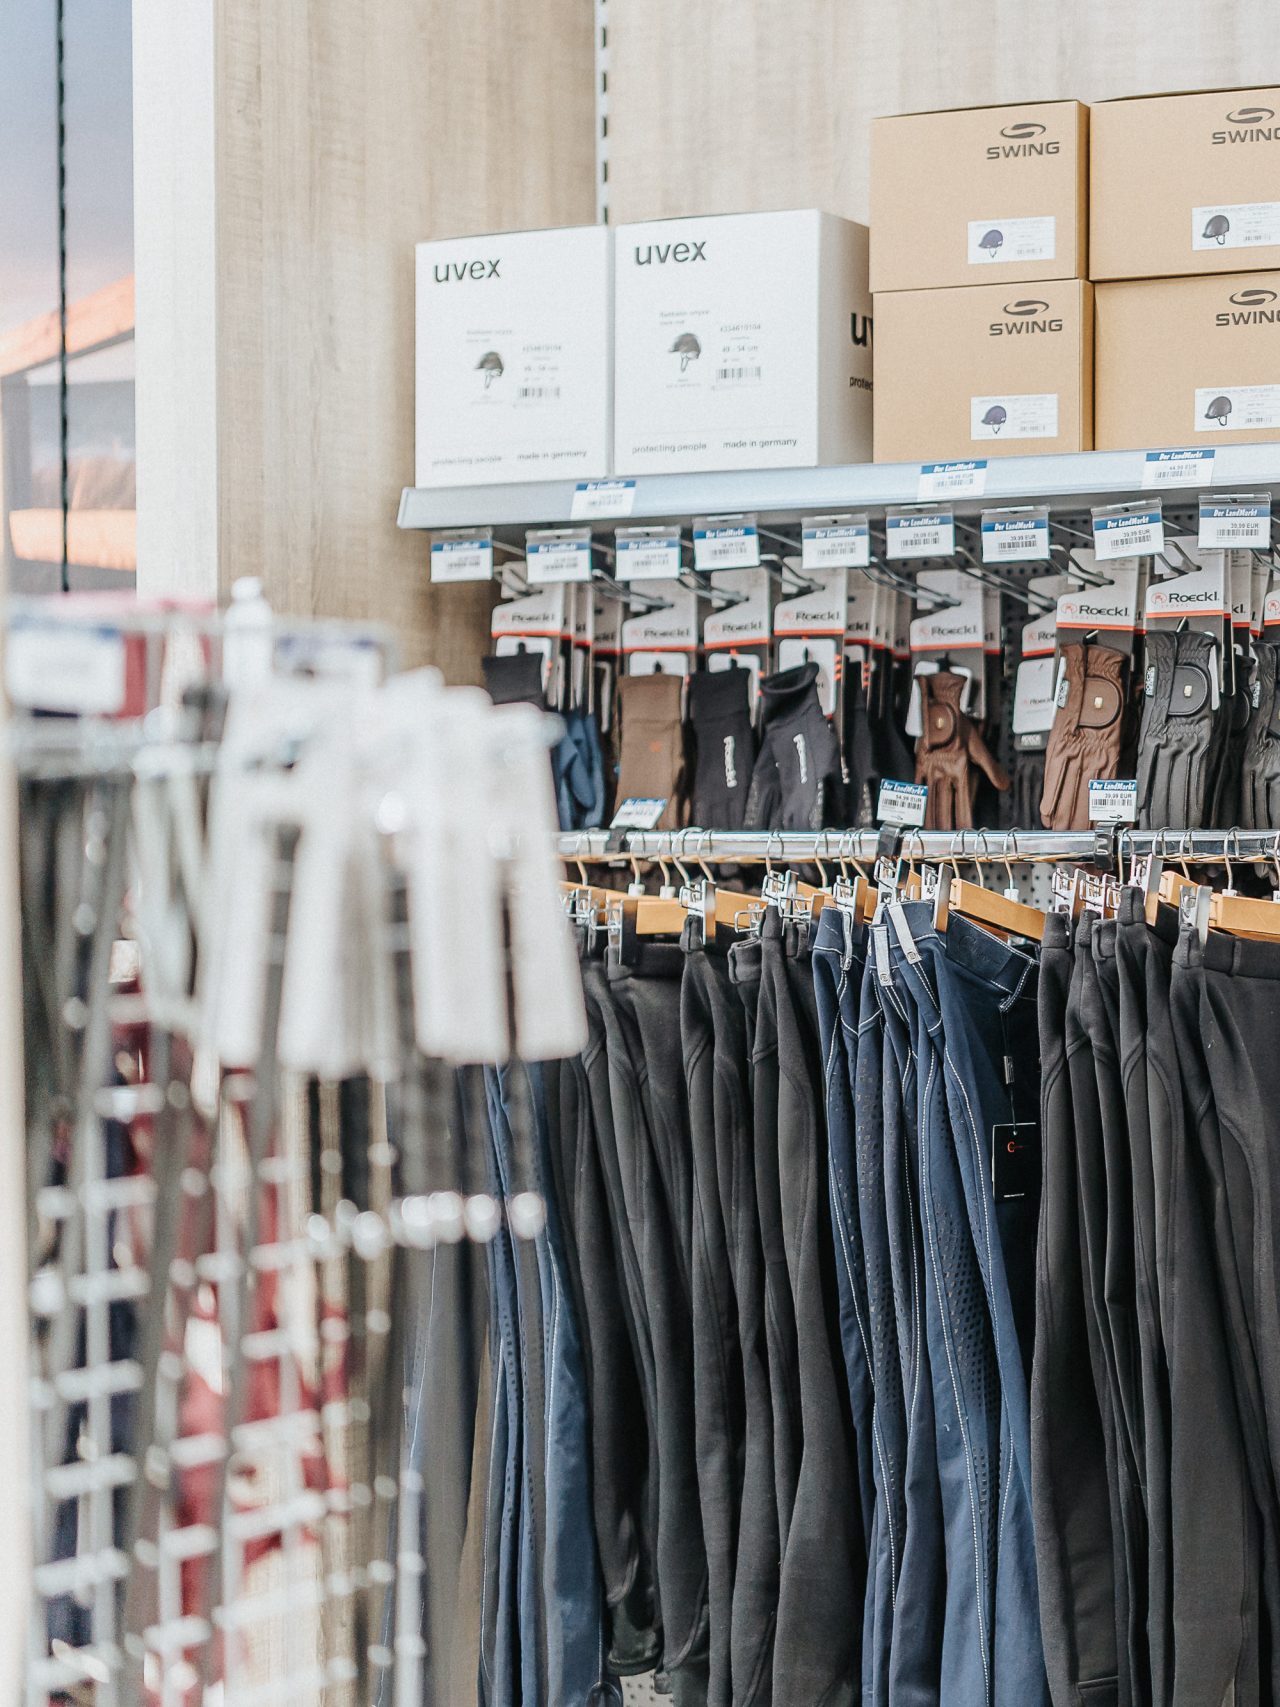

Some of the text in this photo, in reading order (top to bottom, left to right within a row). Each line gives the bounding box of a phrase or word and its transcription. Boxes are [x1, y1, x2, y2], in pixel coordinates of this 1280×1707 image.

[987, 141, 1060, 160] SWING
[635, 240, 707, 266] uvex
[434, 258, 501, 283] uvex
[989, 318, 1063, 337] SWING
[723, 437, 797, 448] made in germany
[632, 442, 707, 455] protecting people
[517, 452, 540, 461] made
[550, 450, 587, 460] germany
[1171, 452, 1203, 460] LandMarkt
[934, 462, 976, 473] Der LandMarkt
[1214, 508, 1257, 517] Der LandMarkt
[900, 518, 940, 527] Der LandMarkt
[995, 522, 1034, 531] Der LandMarkt
[1107, 517, 1149, 528] Der LandMarkt
[706, 531, 715, 539] Der
[816, 530, 825, 538] Der
[1169, 592, 1218, 603] Roeckl
[796, 611, 839, 621] Roeckl
[1079, 605, 1129, 617] Roeckl
[644, 628, 689, 637] Roeckl
[722, 622, 762, 632] Roeckl
[931, 625, 977, 636] Roeckl
[883, 782, 924, 794] Der LandMarkt
[1092, 782, 1135, 790] Der LandMarkt
